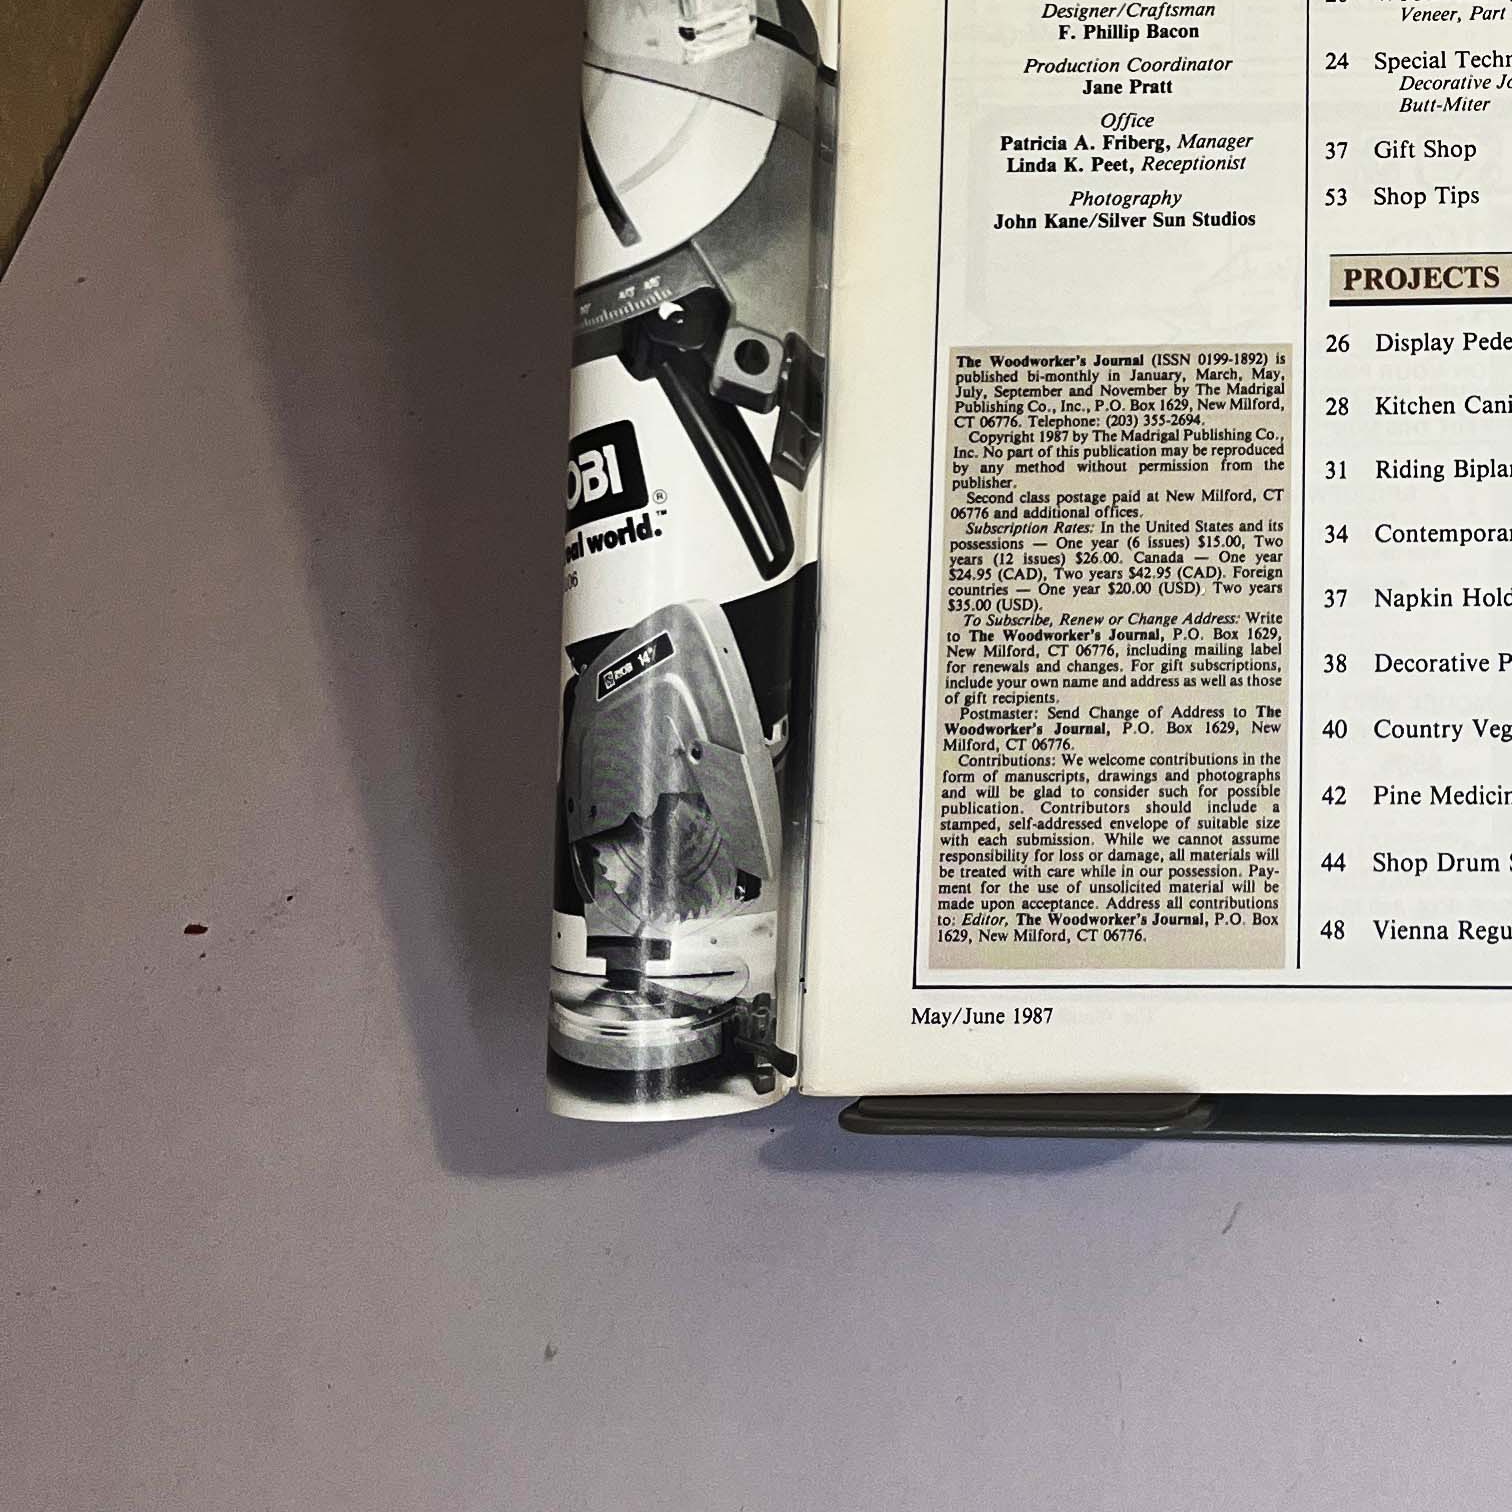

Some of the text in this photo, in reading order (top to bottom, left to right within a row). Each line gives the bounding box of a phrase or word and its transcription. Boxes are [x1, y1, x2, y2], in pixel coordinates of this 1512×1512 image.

[1401, 6, 1462, 24] Veneer,
[1468, 5, 1507, 22] Part
[1324, 51, 1350, 71] 24
[1374, 50, 1447, 75] Special
[1398, 74, 1492, 92] Decorative
[1398, 95, 1492, 113] Butt-Miter
[1324, 139, 1477, 162] 37 Gift Shop
[1324, 184, 1480, 210] 53 Shop Tips
[992, 210, 1257, 230] John Kane/Silver Sun Studios
[1342, 265, 1500, 292] PROJECTS
[1325, 333, 1351, 354] 26
[1375, 331, 1455, 357] Display
[956, 352, 1286, 368] The Woodworker's Journal (ISSN 0199-1892) is
[1325, 396, 1349, 417] 28
[1374, 395, 1456, 416] Kitchen
[954, 413, 1205, 429] CT 06776. Telephone: (203) 355-2694.
[1324, 459, 1347, 481] 31
[1375, 458, 1446, 483] Riding
[587, 513, 663, 554] world.
[1324, 523, 1349, 545] 34
[1323, 588, 1348, 609] 37
[1374, 586, 1454, 613] Napkin
[1323, 652, 1348, 674] 38
[1374, 651, 1490, 674] Decorative
[1321, 718, 1348, 740] 40
[1373, 718, 1464, 743] Country
[1321, 785, 1347, 806] 42
[1373, 784, 1422, 806] Pine
[1320, 851, 1347, 873] 44
[1372, 851, 1429, 878] Shop
[1436, 851, 1501, 873] Drum
[938, 928, 1146, 944] 1629, New Milford, CT 06776.
[1319, 919, 1346, 941] 48
[1372, 918, 1450, 941] Vienna
[910, 1006, 1054, 1029] May/June 1987
